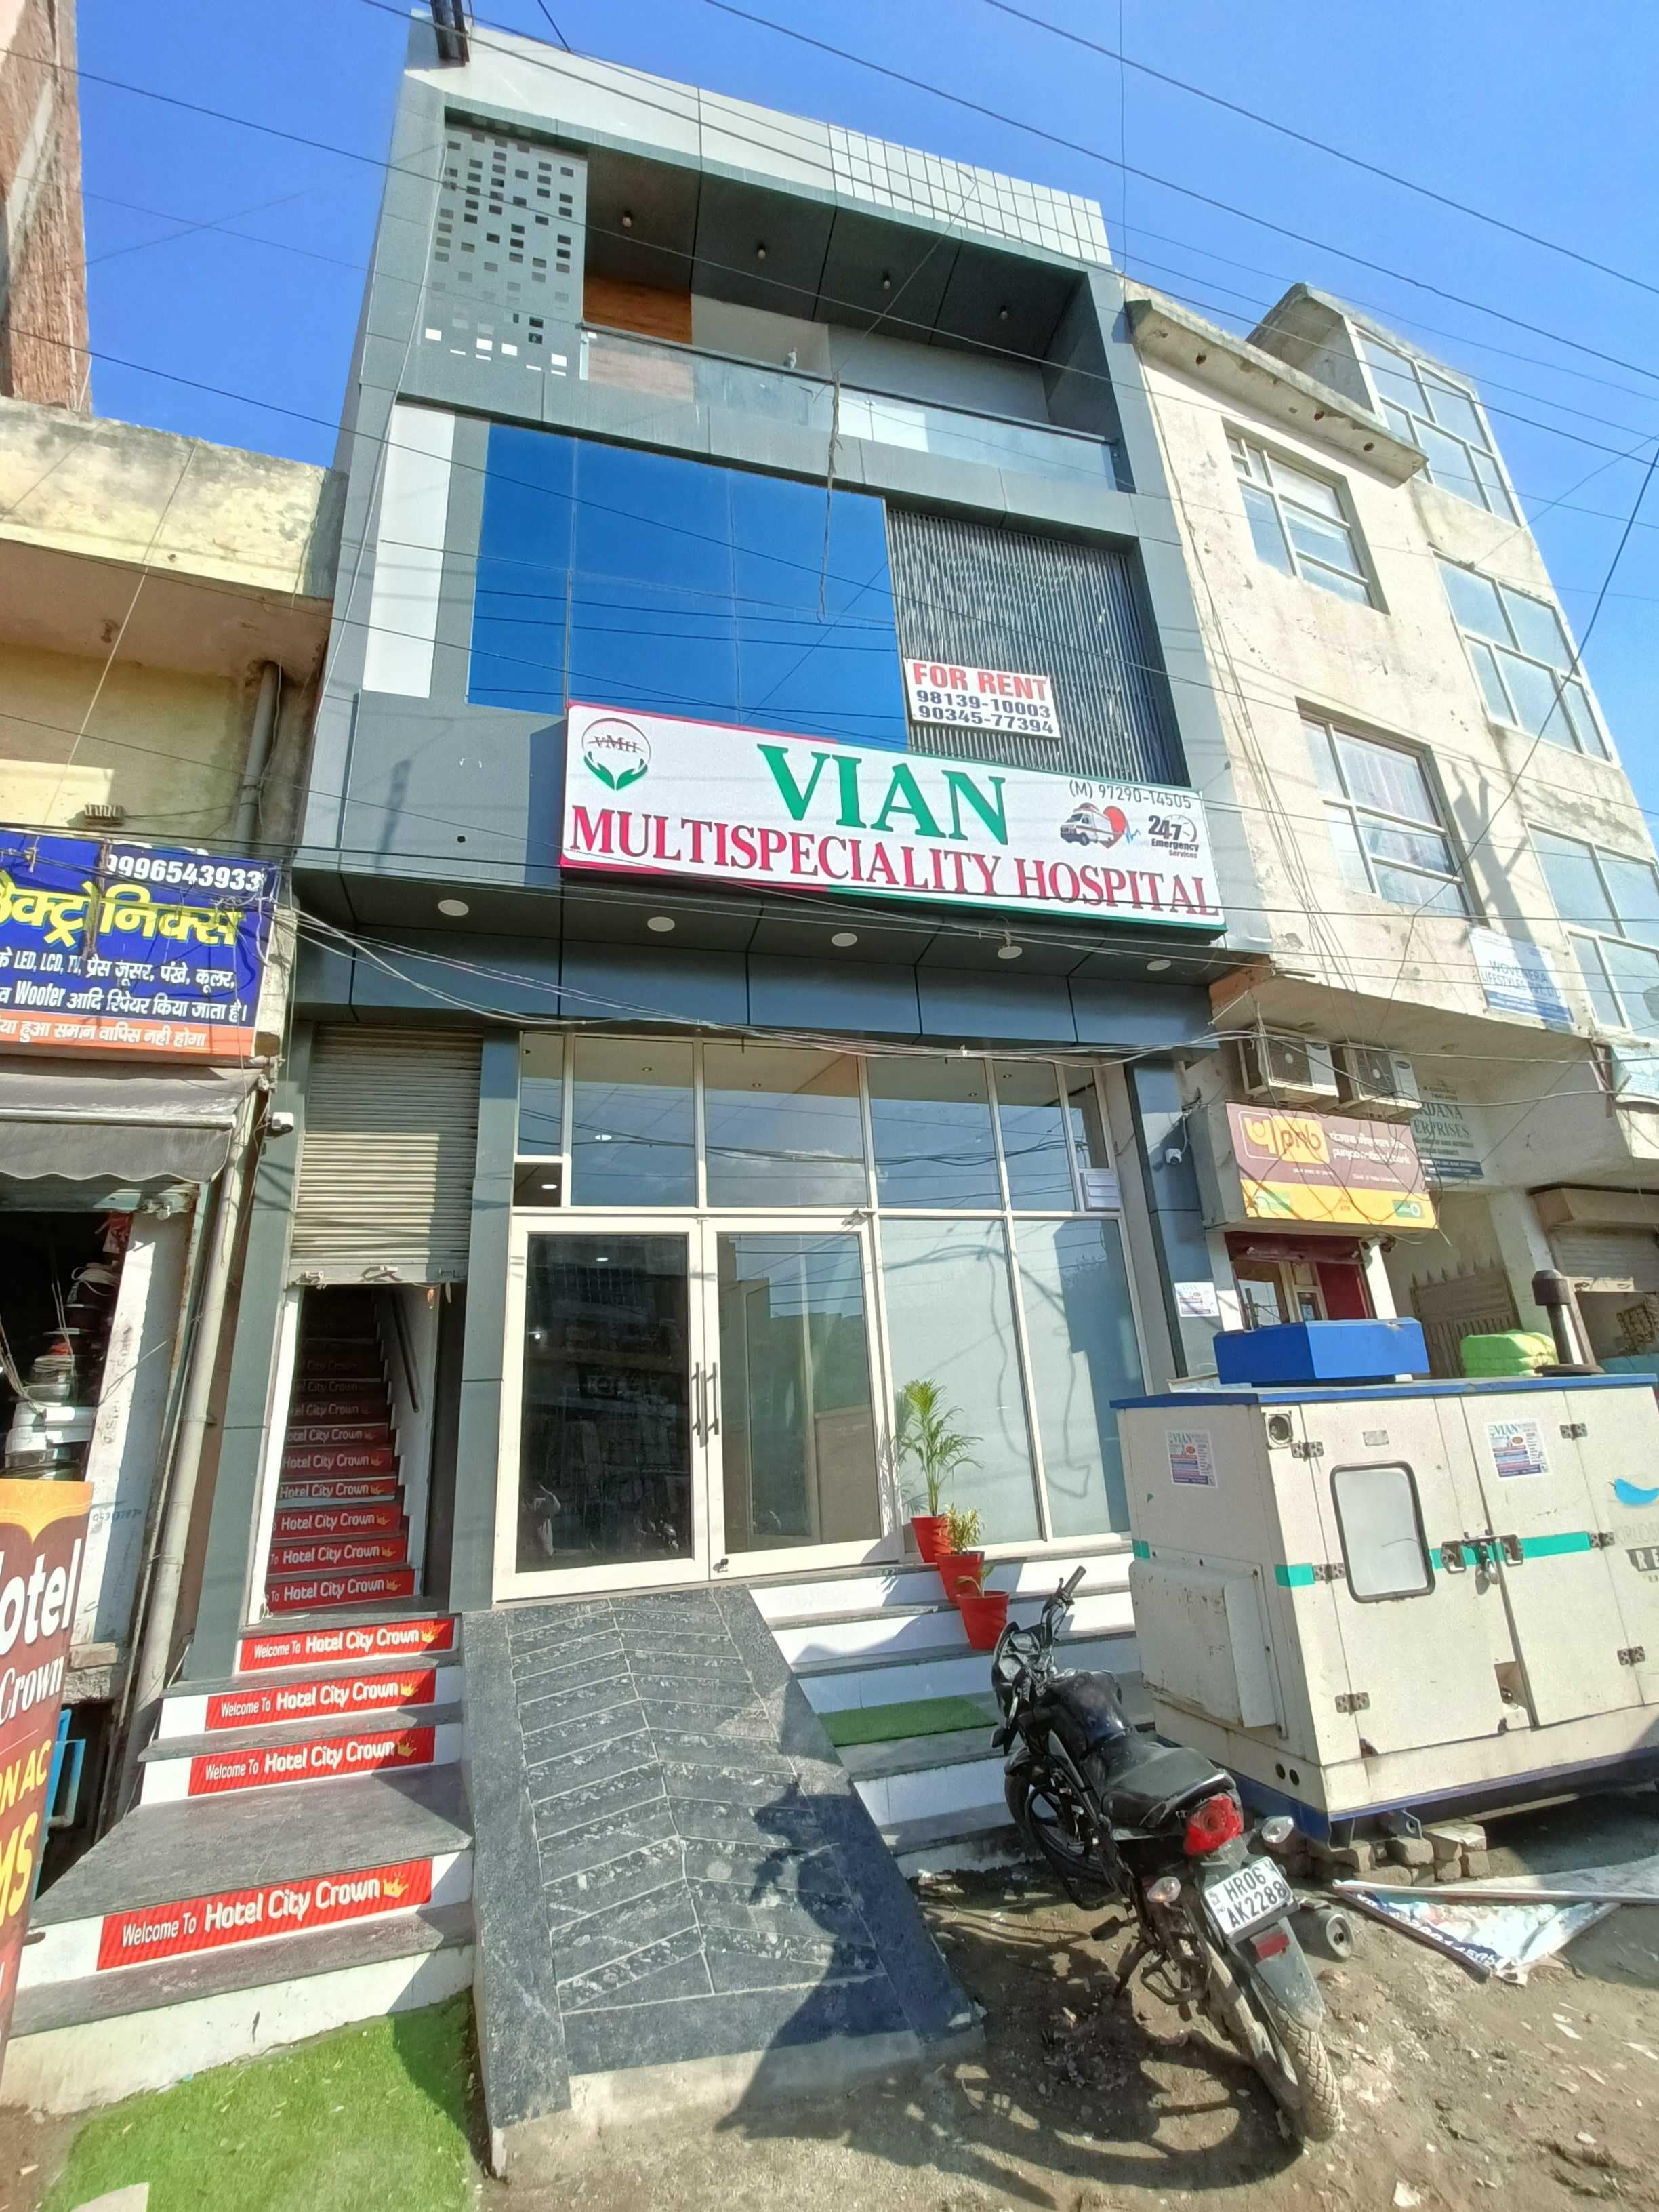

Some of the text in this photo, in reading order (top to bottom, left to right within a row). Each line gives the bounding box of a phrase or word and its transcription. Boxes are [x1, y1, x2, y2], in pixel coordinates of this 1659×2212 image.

[913, 663, 1048, 701] FOR RENT
[916, 689, 1051, 719] 98139-10003
[918, 705, 1054, 735] 90345-77394
[594, 734, 638, 754] VMH
[757, 743, 1008, 846] VIAN
[1069, 779, 1192, 810] (M) 97290-14505
[569, 804, 1220, 917] MULTISPECIALITY HOSPITAL
[1151, 838, 1200, 853] Emergency
[1168, 849, 1198, 859] Services
[14, 950, 37, 973] LED,
[40, 953, 64, 975] LCD,
[14, 980, 66, 1007] Woofer
[287, 1428, 363, 1443] otel City Crown
[313, 1454, 335, 1470] City
[336, 1453, 369, 1467] Crown
[280, 1482, 369, 1500] Hotel City Crown
[281, 1515, 312, 1531] Hotel
[314, 1514, 338, 1531] City
[340, 1513, 375, 1526] Crown
[283, 1549, 315, 1565] Hotel
[317, 1547, 342, 1564] City
[344, 1544, 380, 1560] Crown
[0, 1538, 82, 1656] otel
[271, 1578, 385, 1603] To Hotel City Crown
[254, 1628, 419, 1660] Welcome To Hotel City Crown
[221, 1681, 398, 1719] Welcome To Hotel City Crown
[18, 1739, 52, 1800] AC
[205, 1741, 396, 1782] Welcome To Hotel City Crown
[1223, 1866, 1267, 1902] HR06
[121, 1877, 380, 1948] Welcome To Hotel City Crown
[1225, 1880, 1288, 1929] AK2288
